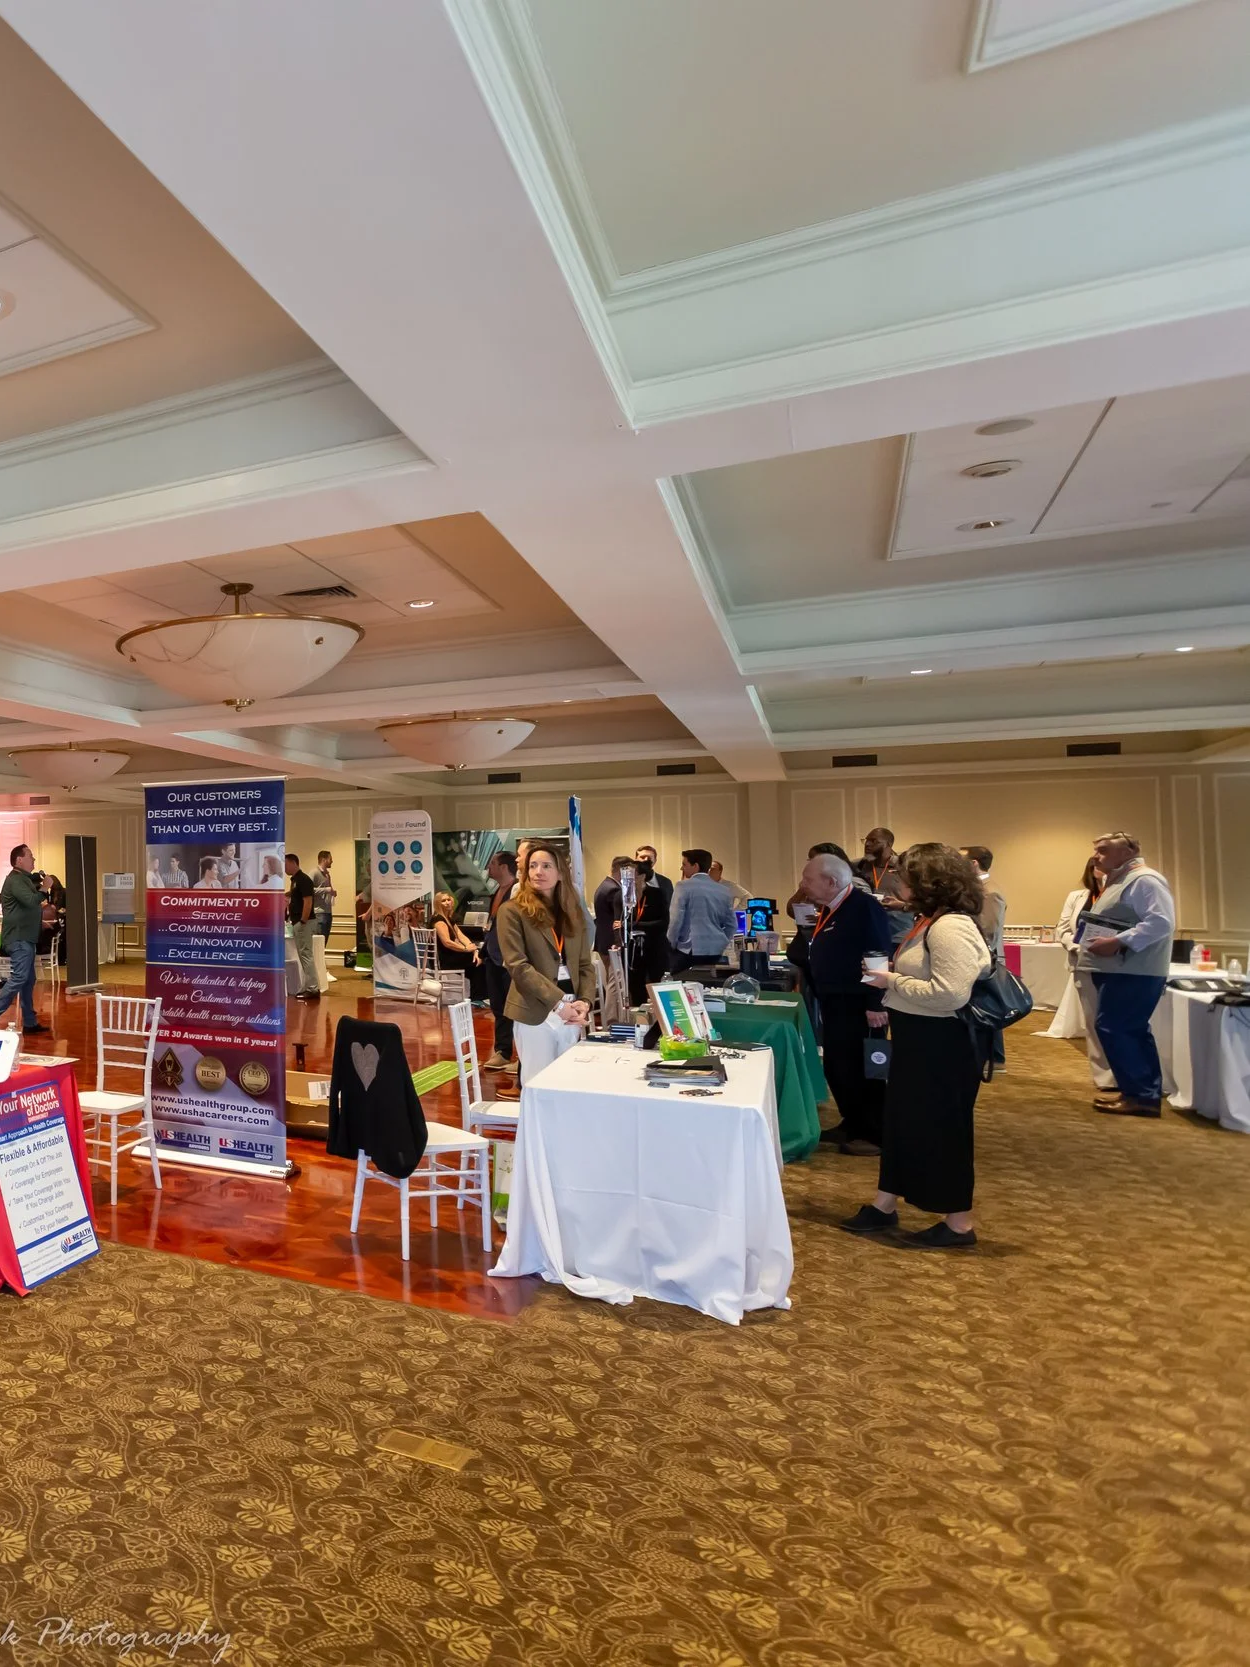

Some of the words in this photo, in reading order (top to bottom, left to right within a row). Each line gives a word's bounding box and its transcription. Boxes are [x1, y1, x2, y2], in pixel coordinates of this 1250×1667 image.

[168, 793, 190, 802] OUR
[194, 790, 261, 801] CUSTOMERS
[148, 809, 194, 818] DESERVE
[197, 807, 245, 816] NOTHING
[249, 806, 281, 815] LESS,
[183, 825, 205, 833] OUR
[208, 824, 236, 832] VERY
[161, 896, 241, 907] COMMITMENT
[244, 899, 259, 907] TO
[192, 975, 226, 986] dedicated
[228, 977, 237, 987] to
[239, 978, 267, 993] helping
[191, 990, 231, 1003] Customers
[234, 995, 251, 1005] with
[186, 1009, 209, 1019] health
[212, 1014, 244, 1026] coverage
[246, 1015, 281, 1025] solutions
[183, 1033, 212, 1041] Awards
[251, 1039, 277, 1047] years!
[202, 1070, 221, 1078] BEST
[20, 1087, 56, 1108] Network
[27, 1105, 33, 1116] of
[34, 1100, 59, 1114] Doctors
[151, 1095, 274, 1116] www.ushealthgroup.com
[155, 1105, 269, 1126] www.ushacareers.com
[8, 1127, 28, 1140] Approach
[33, 1123, 46, 1131] Health
[0, 1149, 25, 1164] Flexible
[27, 1145, 31, 1154] &
[33, 1135, 63, 1152] Affordable
[9, 1164, 28, 1177] Coverage
[15, 1177, 35, 1189] Coverage
[22, 1213, 45, 1227] Customize
